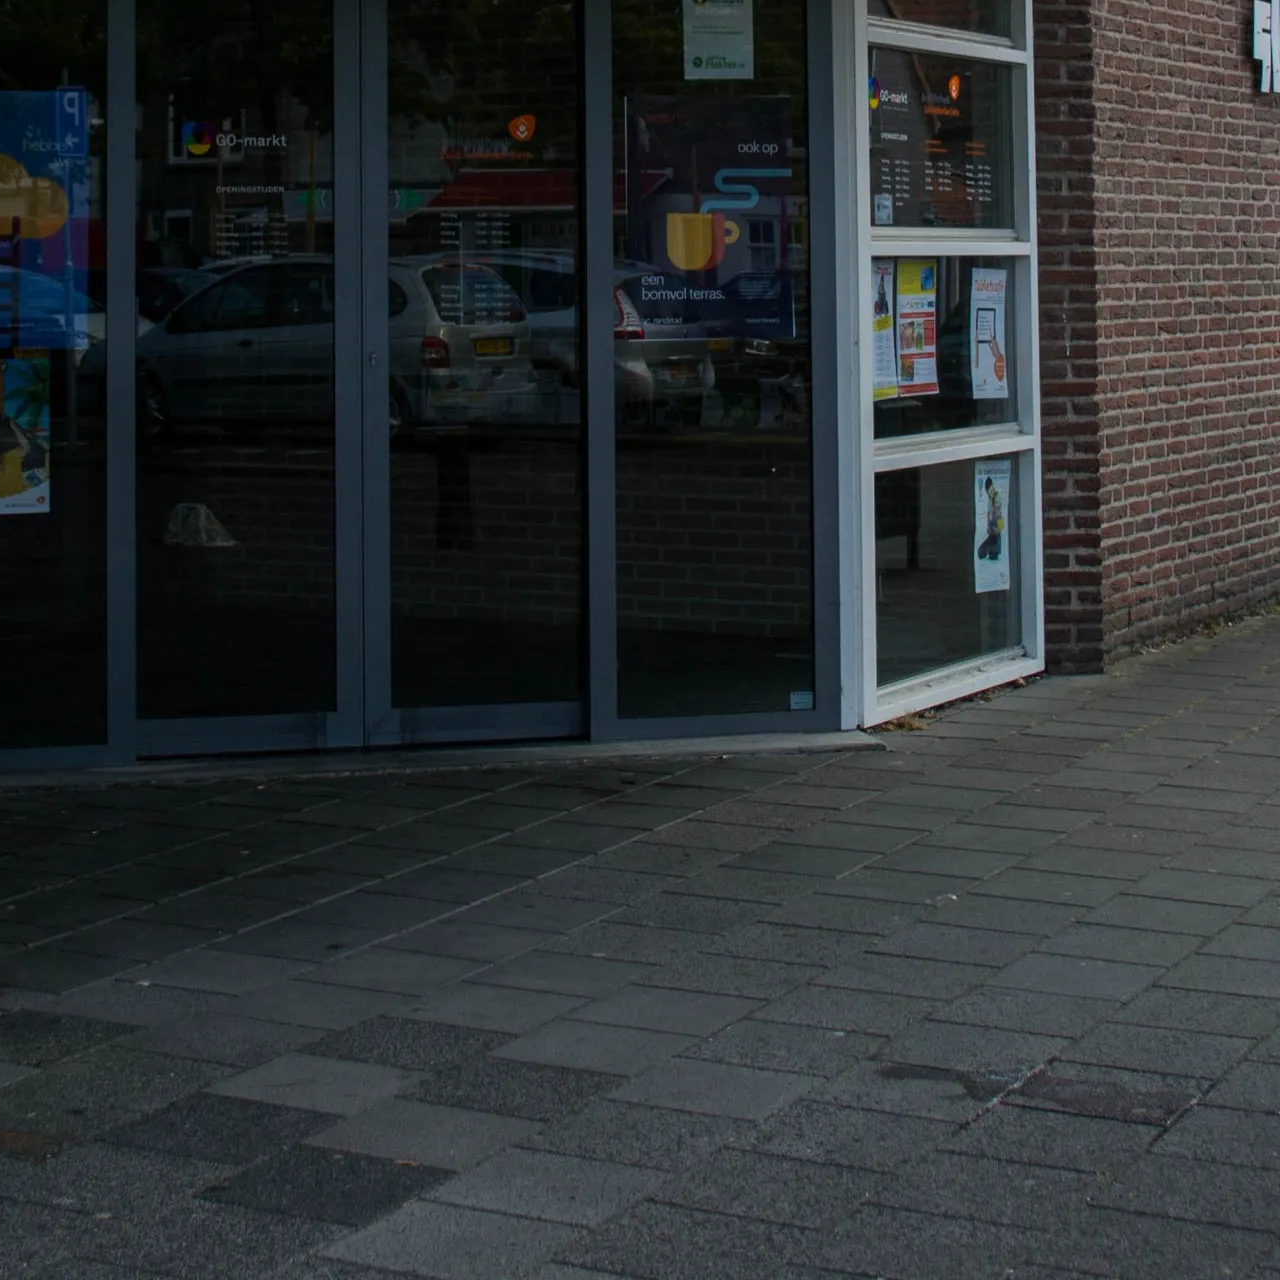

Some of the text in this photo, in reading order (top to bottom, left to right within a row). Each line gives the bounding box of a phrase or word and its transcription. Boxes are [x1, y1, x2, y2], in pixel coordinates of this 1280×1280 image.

[215, 133, 288, 148] GO-markt
[737, 140, 779, 156] ook op
[641, 275, 665, 286] een
[641, 287, 726, 301] bomvol terras.
